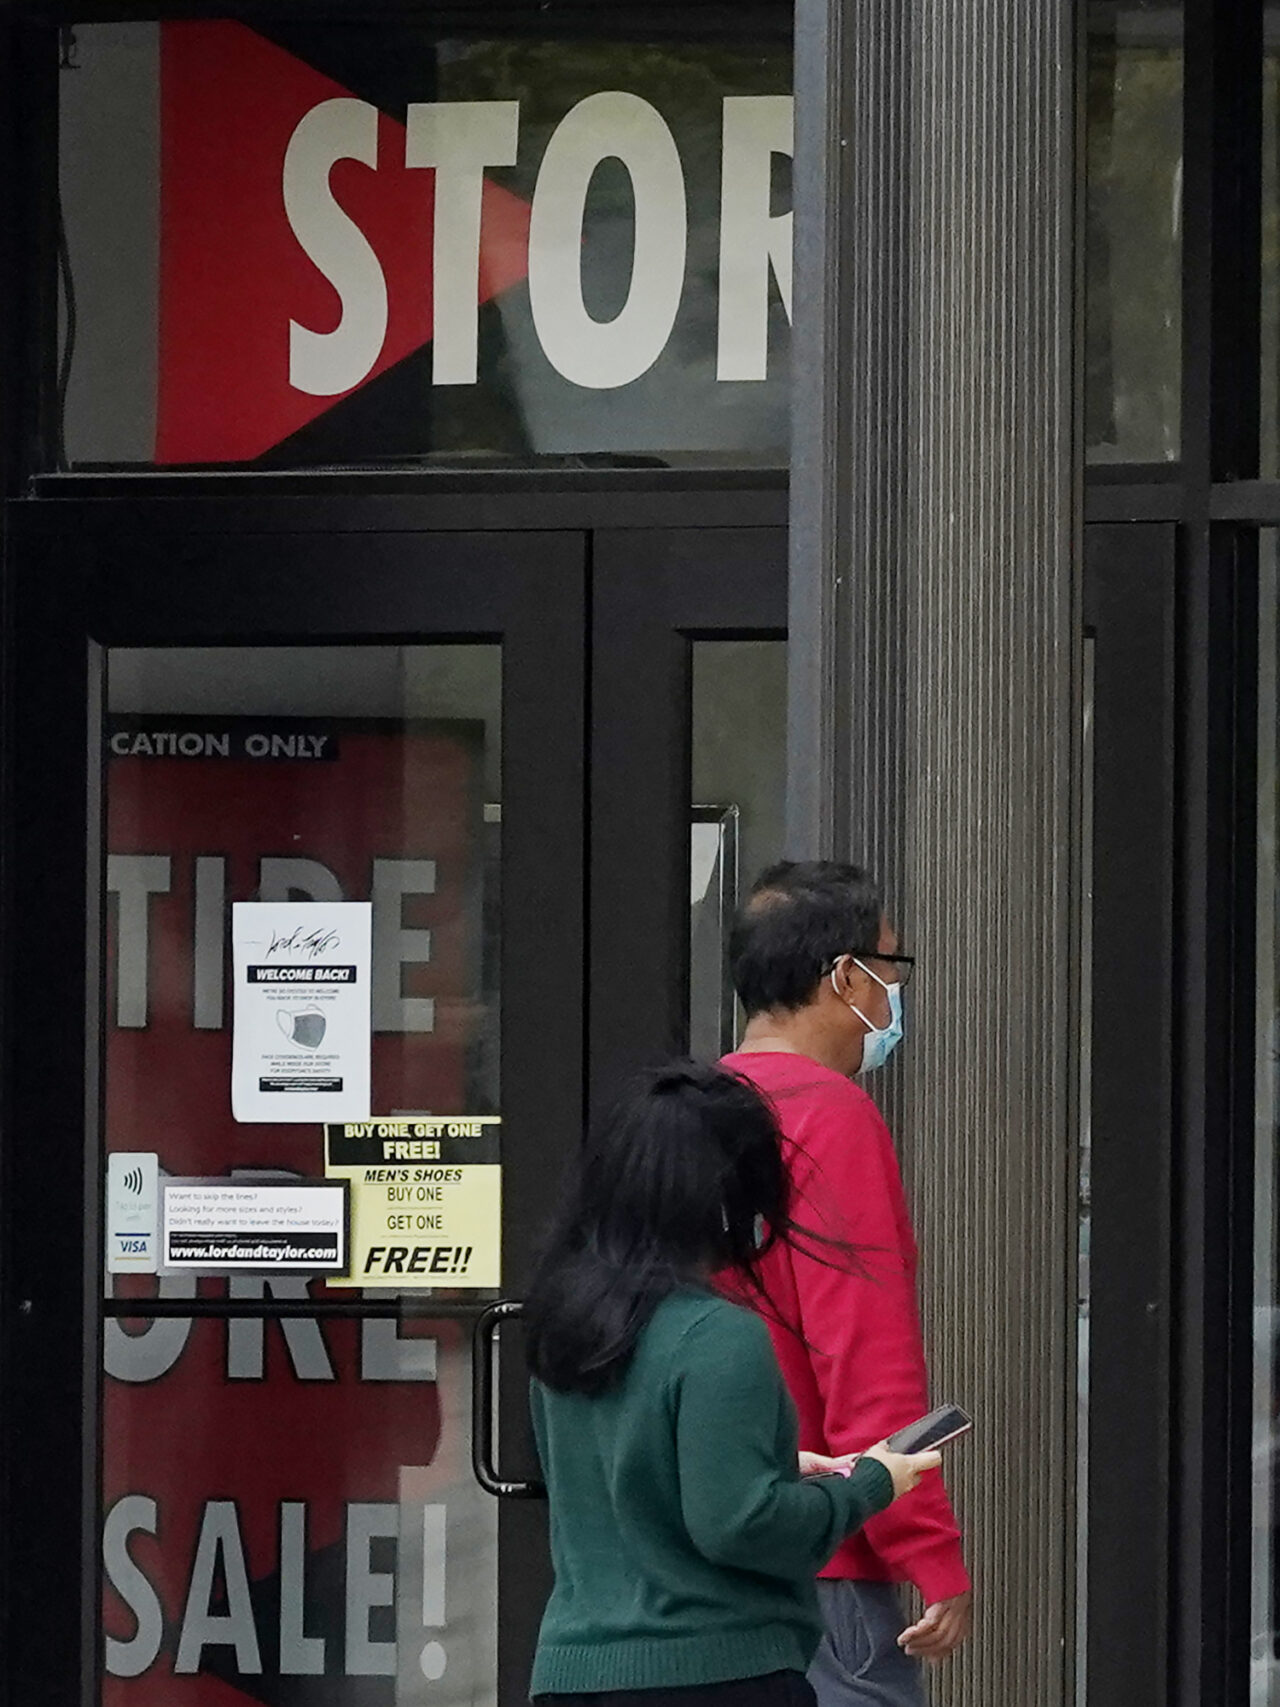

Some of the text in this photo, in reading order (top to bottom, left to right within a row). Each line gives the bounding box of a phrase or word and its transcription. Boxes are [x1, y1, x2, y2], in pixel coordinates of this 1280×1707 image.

[110, 732, 327, 758] CATION ONLY
[107, 855, 436, 1032] TIE
[256, 969, 349, 980] WELCOME BACK!
[344, 1124, 374, 1138] BUY
[414, 1124, 444, 1137] GET
[448, 1124, 482, 1137] ONE
[383, 1141, 440, 1160] FREE!
[364, 1169, 463, 1182] MEN'S SHOES
[387, 1187, 443, 1201] BUY ONE
[169, 1206, 201, 1215] Looking
[387, 1215, 443, 1229] GET ONE
[121, 1241, 147, 1252] VISA
[170, 1244, 337, 1261] www.lordandtaylor.com
[363, 1246, 473, 1274] FREE!!
[103, 1495, 447, 1681] SALE!
